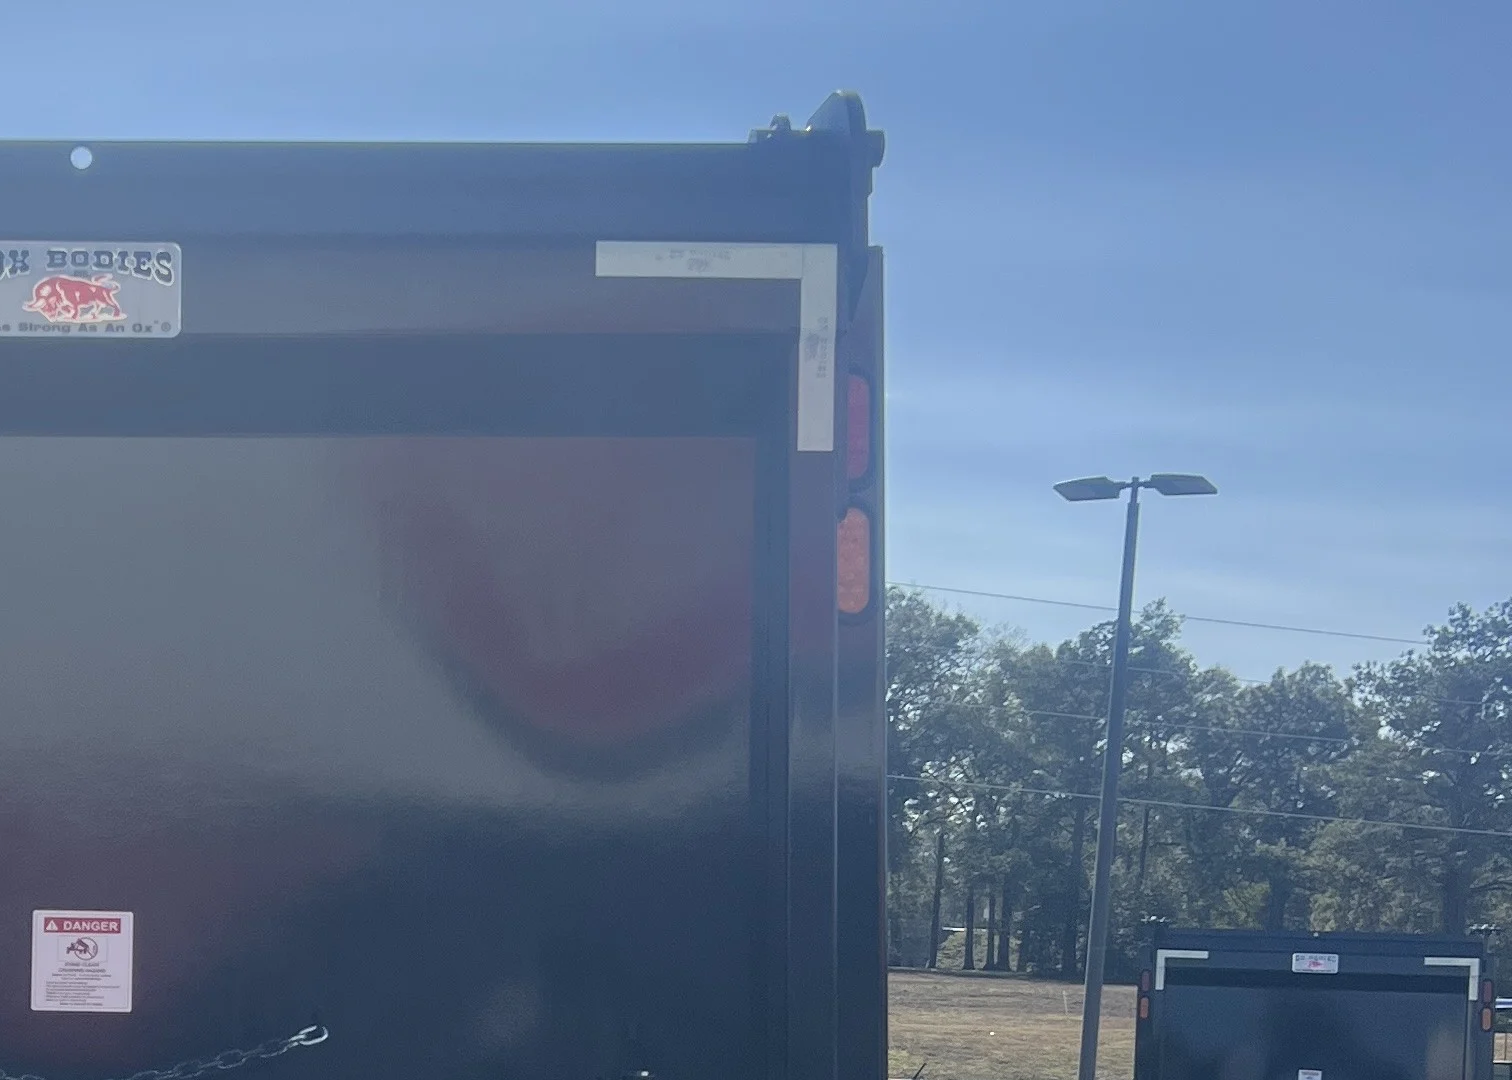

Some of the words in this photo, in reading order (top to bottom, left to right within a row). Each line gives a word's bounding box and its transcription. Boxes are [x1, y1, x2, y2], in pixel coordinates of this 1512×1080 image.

[46, 249, 174, 286] BODIES
[18, 322, 71, 333] Strong
[78, 322, 98, 332] As
[105, 322, 125, 332] An
[63, 921, 119, 932] DANGER
